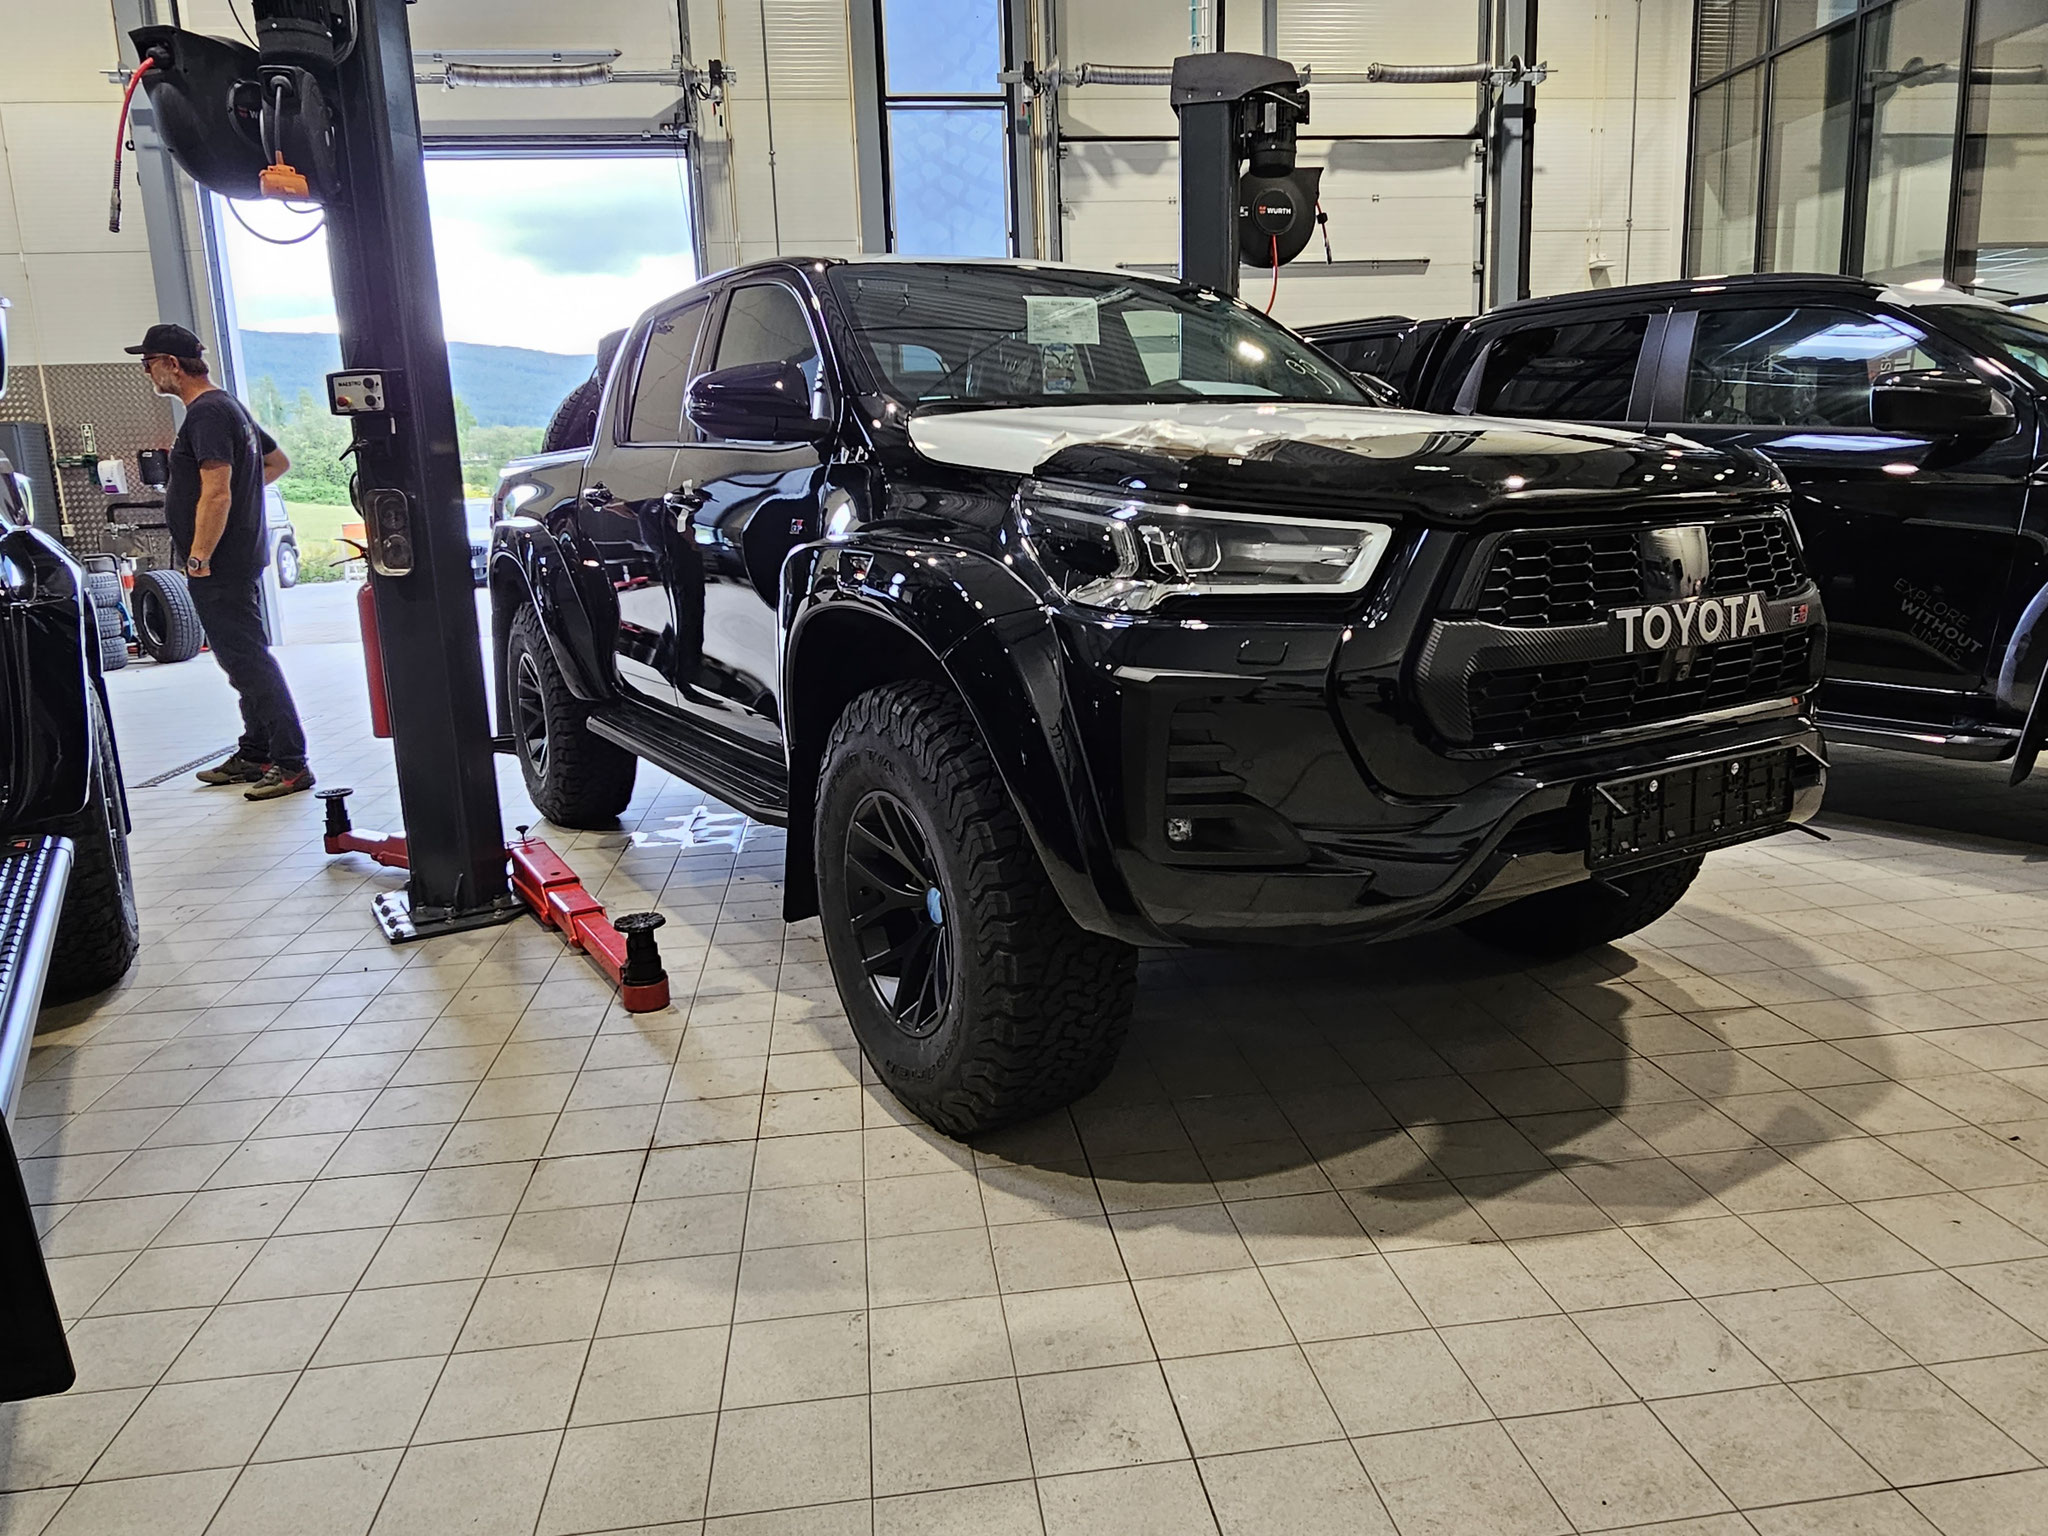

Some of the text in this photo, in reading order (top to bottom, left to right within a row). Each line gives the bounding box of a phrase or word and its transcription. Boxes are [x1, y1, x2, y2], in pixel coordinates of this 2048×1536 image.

[1616, 594, 1766, 653] TOYOTA
[1894, 577, 1971, 629] EXPLORE
[1901, 598, 1983, 653] WITHOUT
[1910, 622, 1964, 661] LIMITS
